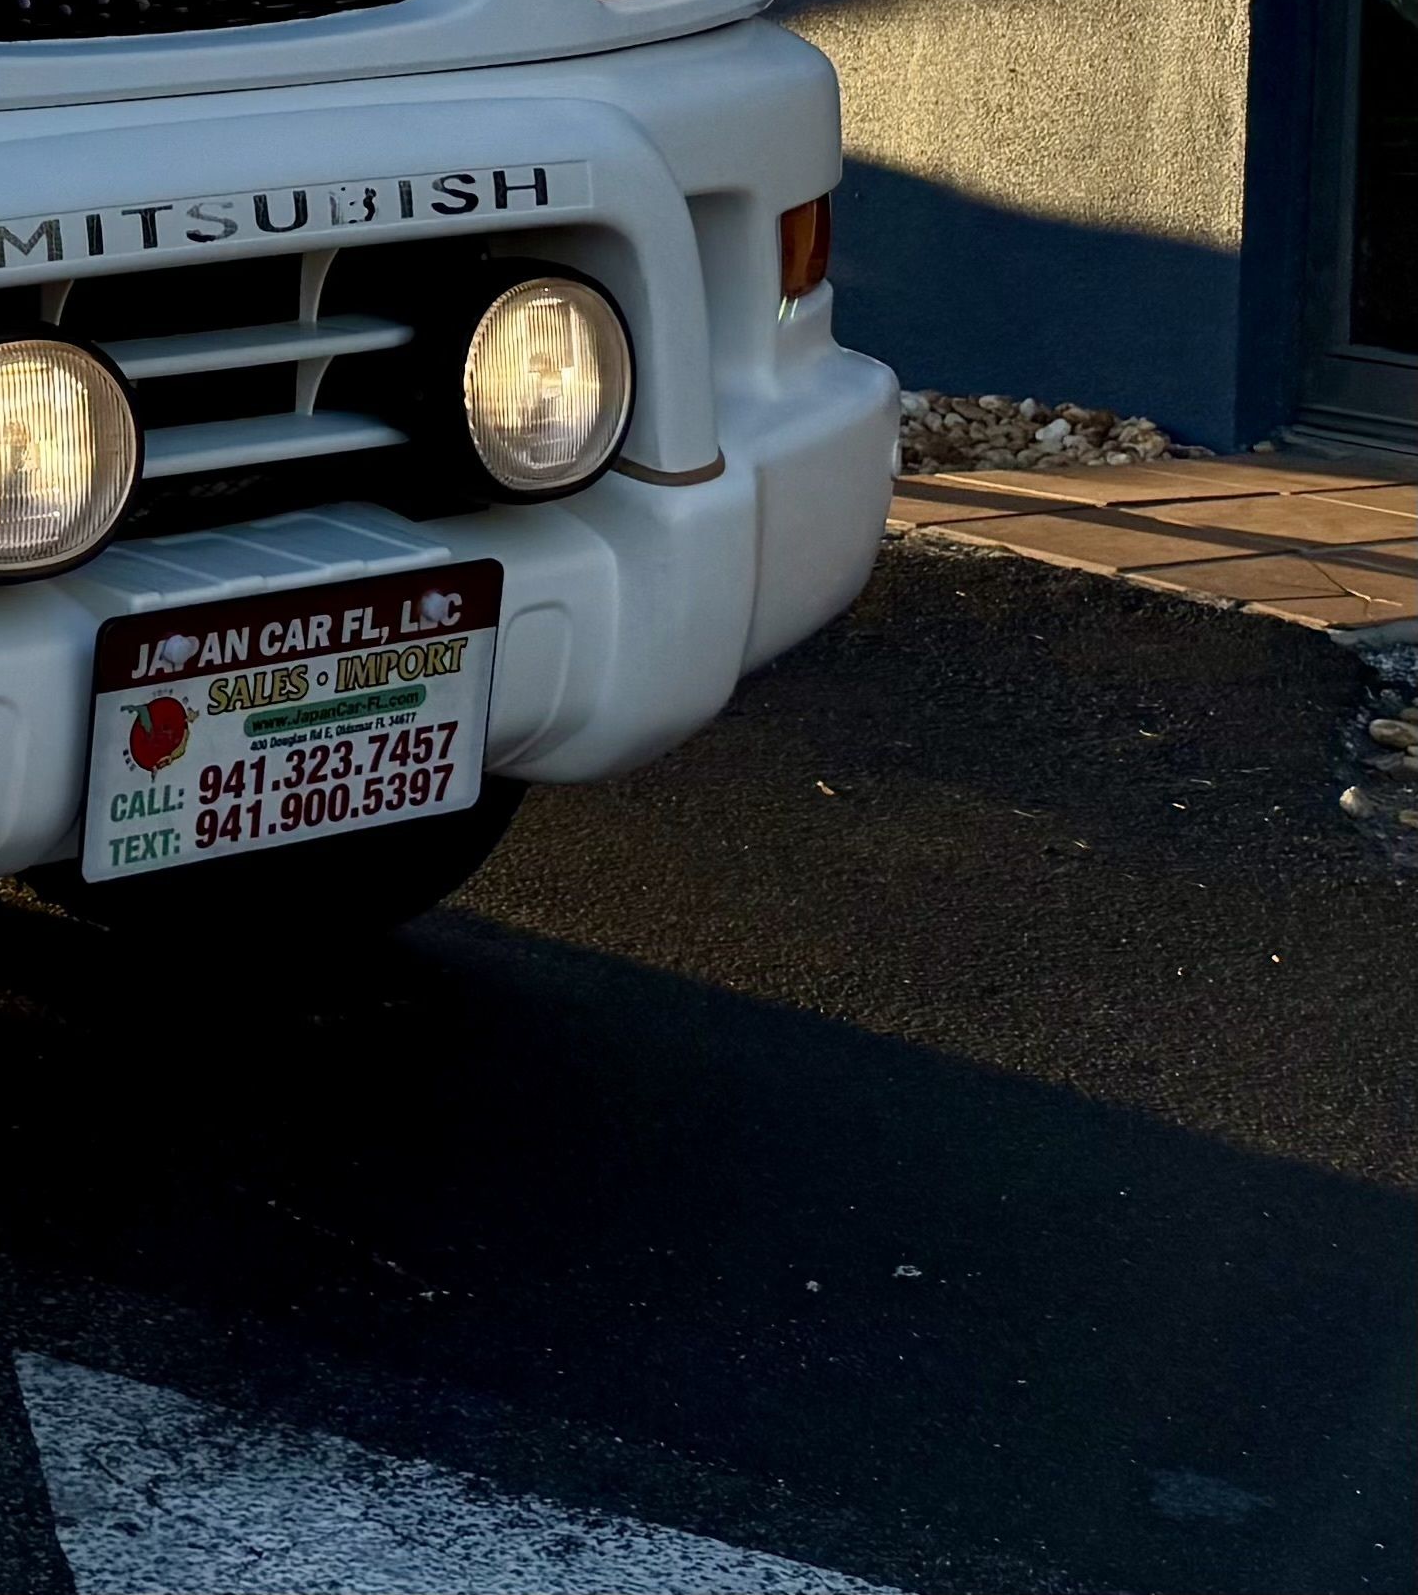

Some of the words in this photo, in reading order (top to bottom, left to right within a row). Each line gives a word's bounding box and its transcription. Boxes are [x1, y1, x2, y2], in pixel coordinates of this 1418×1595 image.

[259, 614, 332, 658] CAR
[340, 607, 389, 644] FL,
[207, 664, 309, 715] SALES
[335, 639, 469, 694] IMPORT
[252, 691, 418, 733] www.JapanCar-FL.com
[310, 729, 322, 740] Rd
[375, 716, 385, 729] FL
[111, 785, 185, 822] CALL:
[199, 723, 459, 804] 941.323.7457
[110, 829, 181, 866] TEXT:
[196, 765, 454, 849] 941.900.5397
